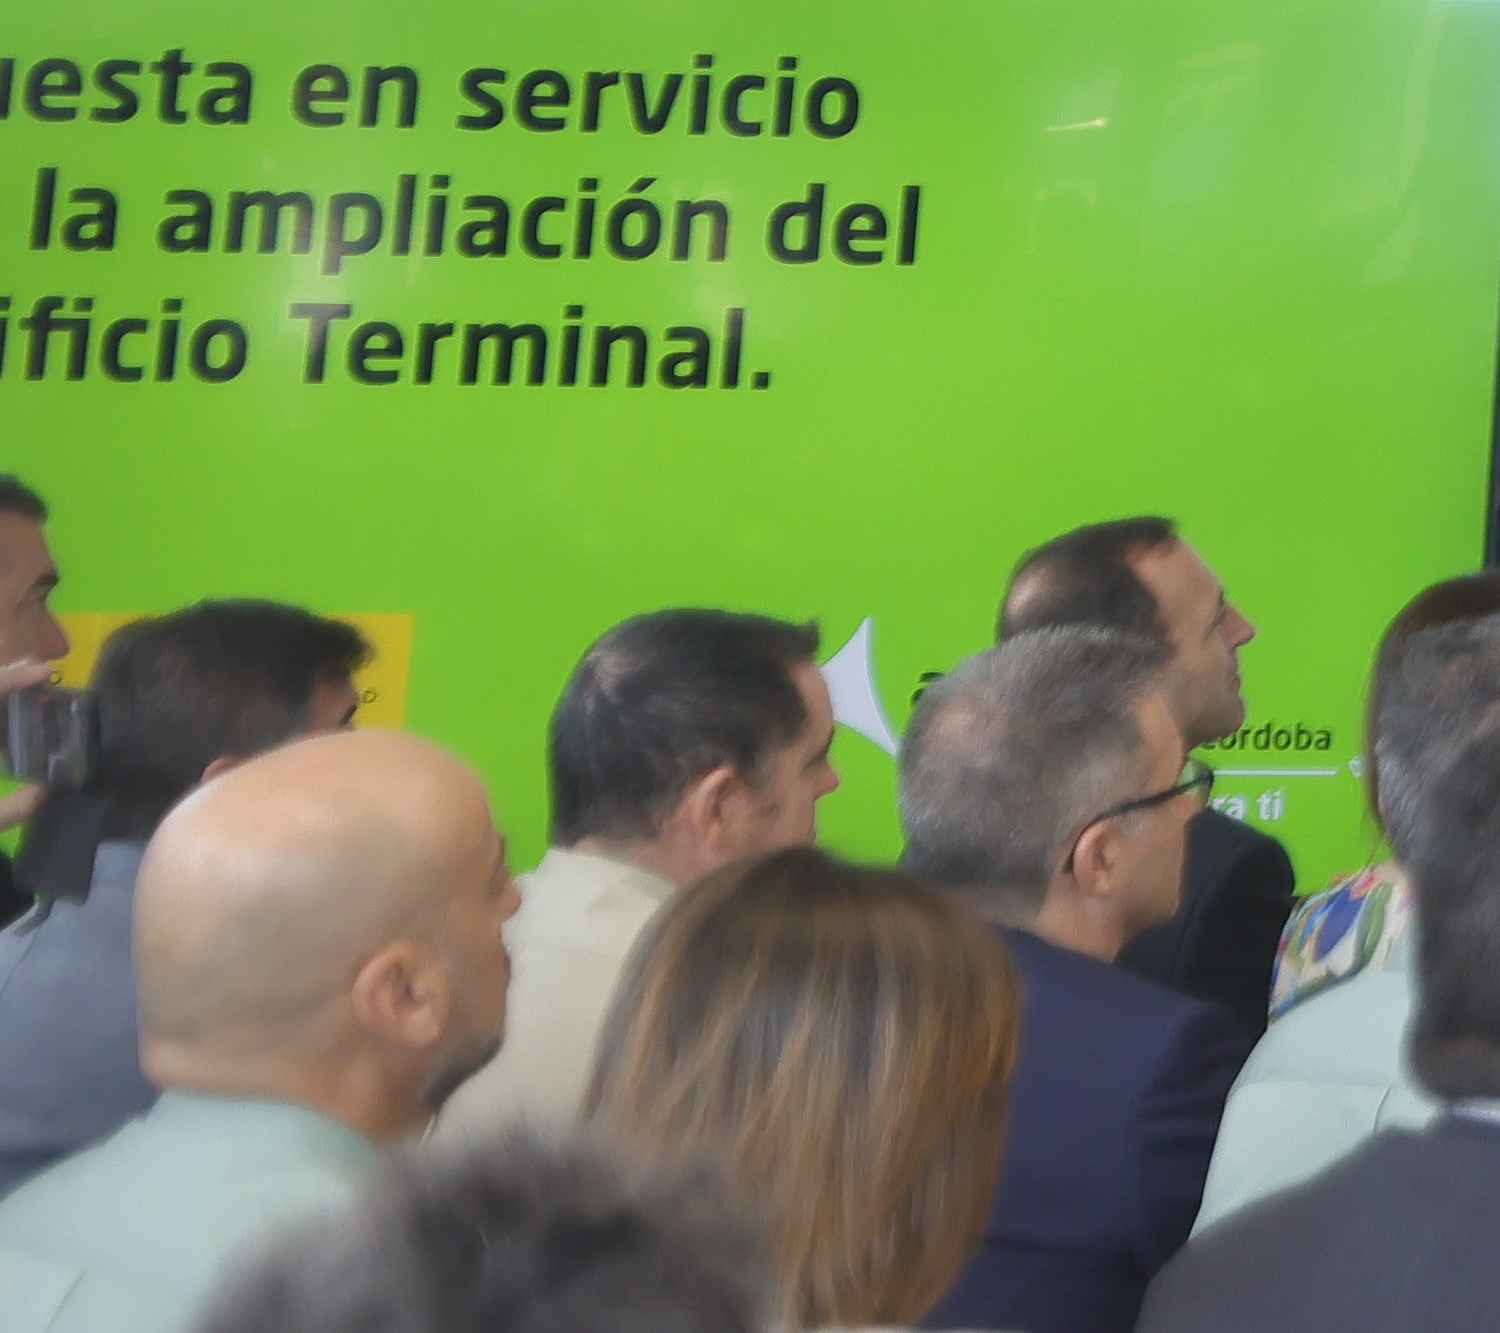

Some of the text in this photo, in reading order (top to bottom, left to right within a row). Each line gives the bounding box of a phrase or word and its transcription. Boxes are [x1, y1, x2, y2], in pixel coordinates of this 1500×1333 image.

[291, 63, 420, 129] en
[454, 53, 860, 139] servicio
[28, 166, 921, 276] la ampliación del
[288, 302, 772, 391] Terminal.
[1256, 789, 1285, 821] ti
